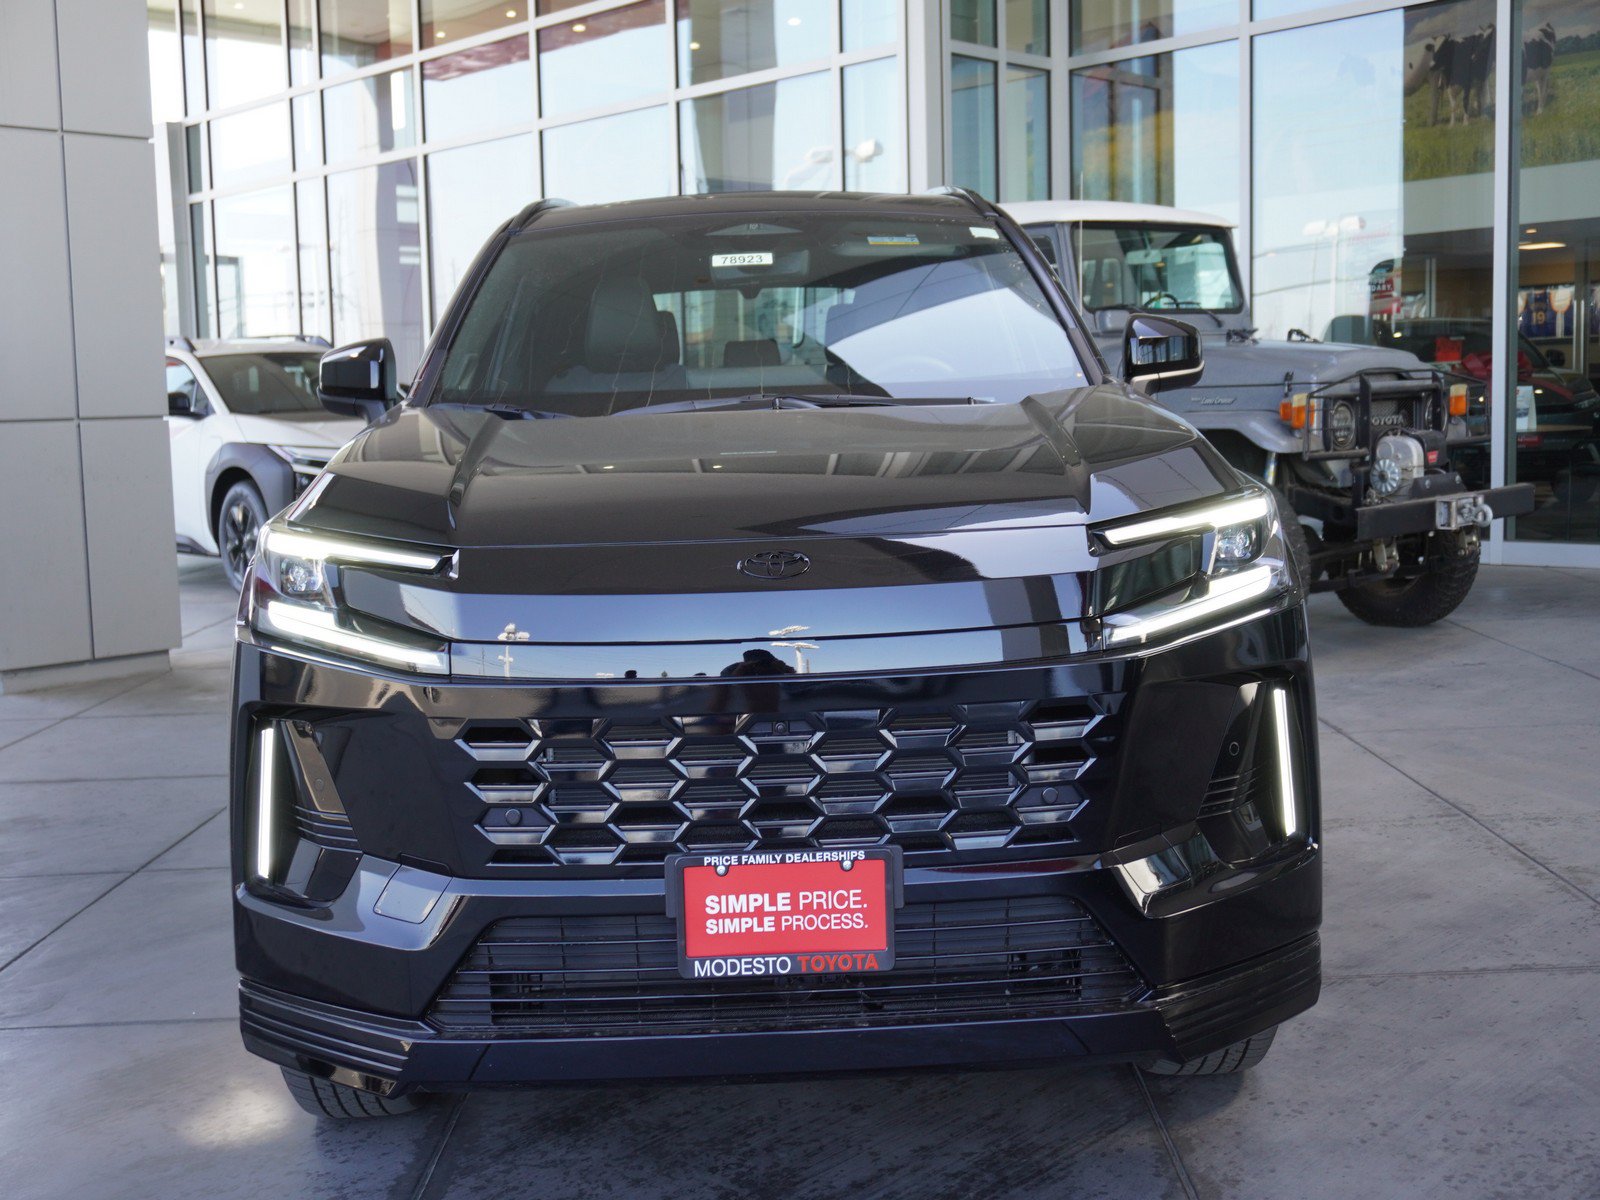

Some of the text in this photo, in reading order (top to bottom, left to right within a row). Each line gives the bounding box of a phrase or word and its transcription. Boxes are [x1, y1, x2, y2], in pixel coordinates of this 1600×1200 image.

[721, 255, 763, 265] 78923
[1371, 414, 1405, 426] OYOTA
[703, 850, 866, 866] PRICE FAMILY DEALERSHIPS
[705, 889, 868, 915] SIMPLE PRICE.
[705, 913, 869, 935] SIMPLE PROCESS.
[694, 953, 879, 978] MODESTO TOYOTA
